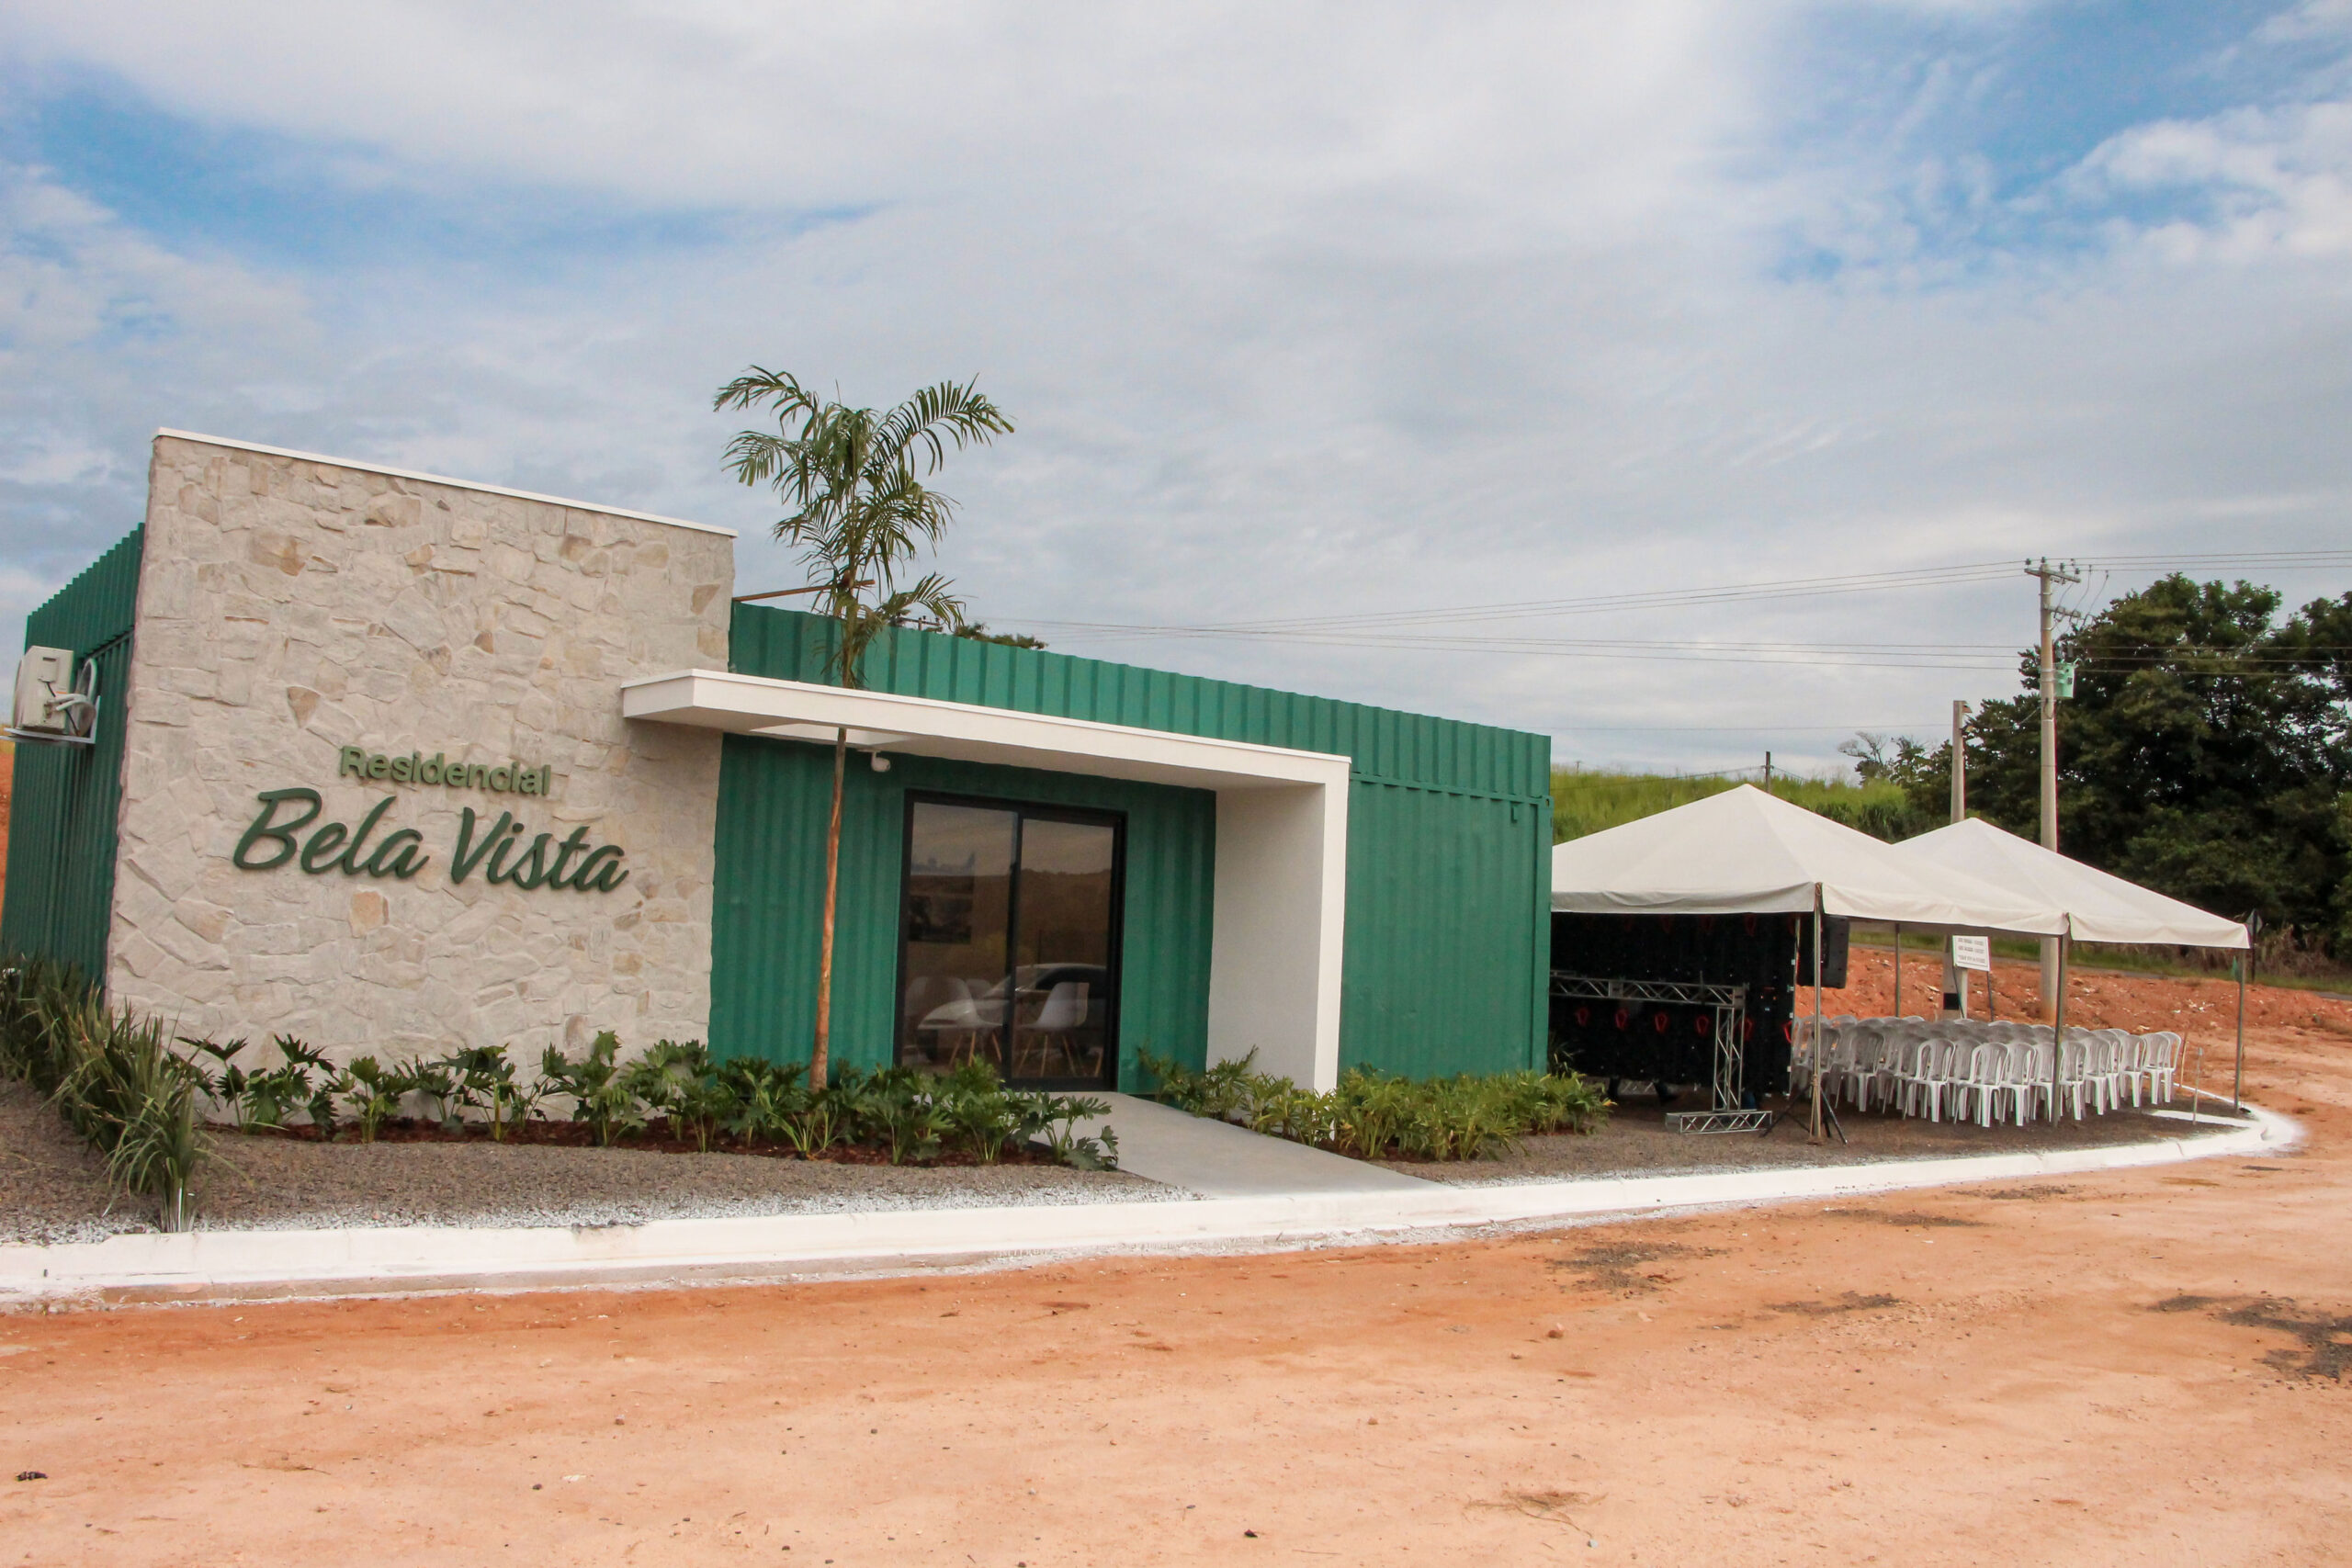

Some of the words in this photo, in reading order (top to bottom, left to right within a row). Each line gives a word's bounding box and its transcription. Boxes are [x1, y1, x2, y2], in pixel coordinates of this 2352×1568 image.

[340, 745, 551, 796] Residencial
[232, 787, 431, 879] Bela
[450, 807, 629, 892] Vista
